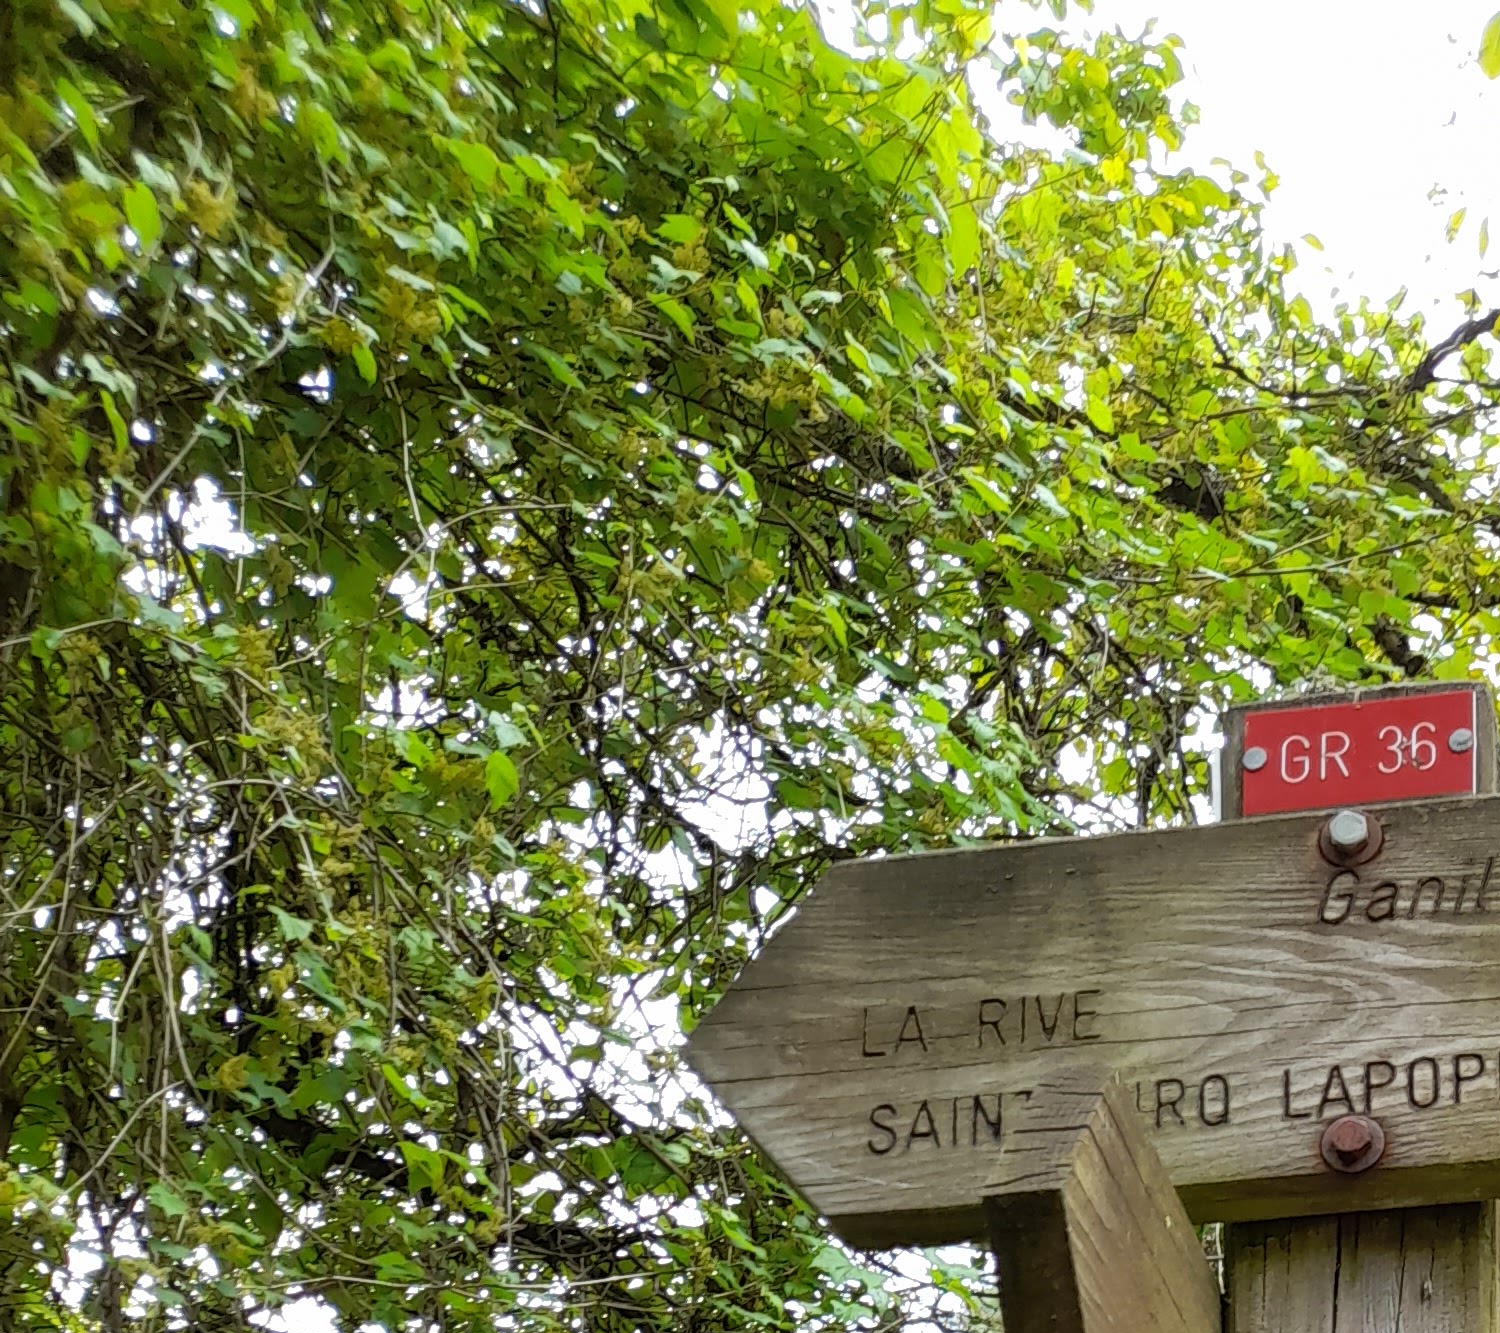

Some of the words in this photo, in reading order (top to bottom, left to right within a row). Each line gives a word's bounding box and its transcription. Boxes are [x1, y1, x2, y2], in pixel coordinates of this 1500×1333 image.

[1280, 730, 1350, 783] GR
[1377, 721, 1437, 774] 36
[1318, 856, 1495, 925] Ganil
[861, 1005, 928, 1058] LA
[978, 989, 1102, 1049] RIVE
